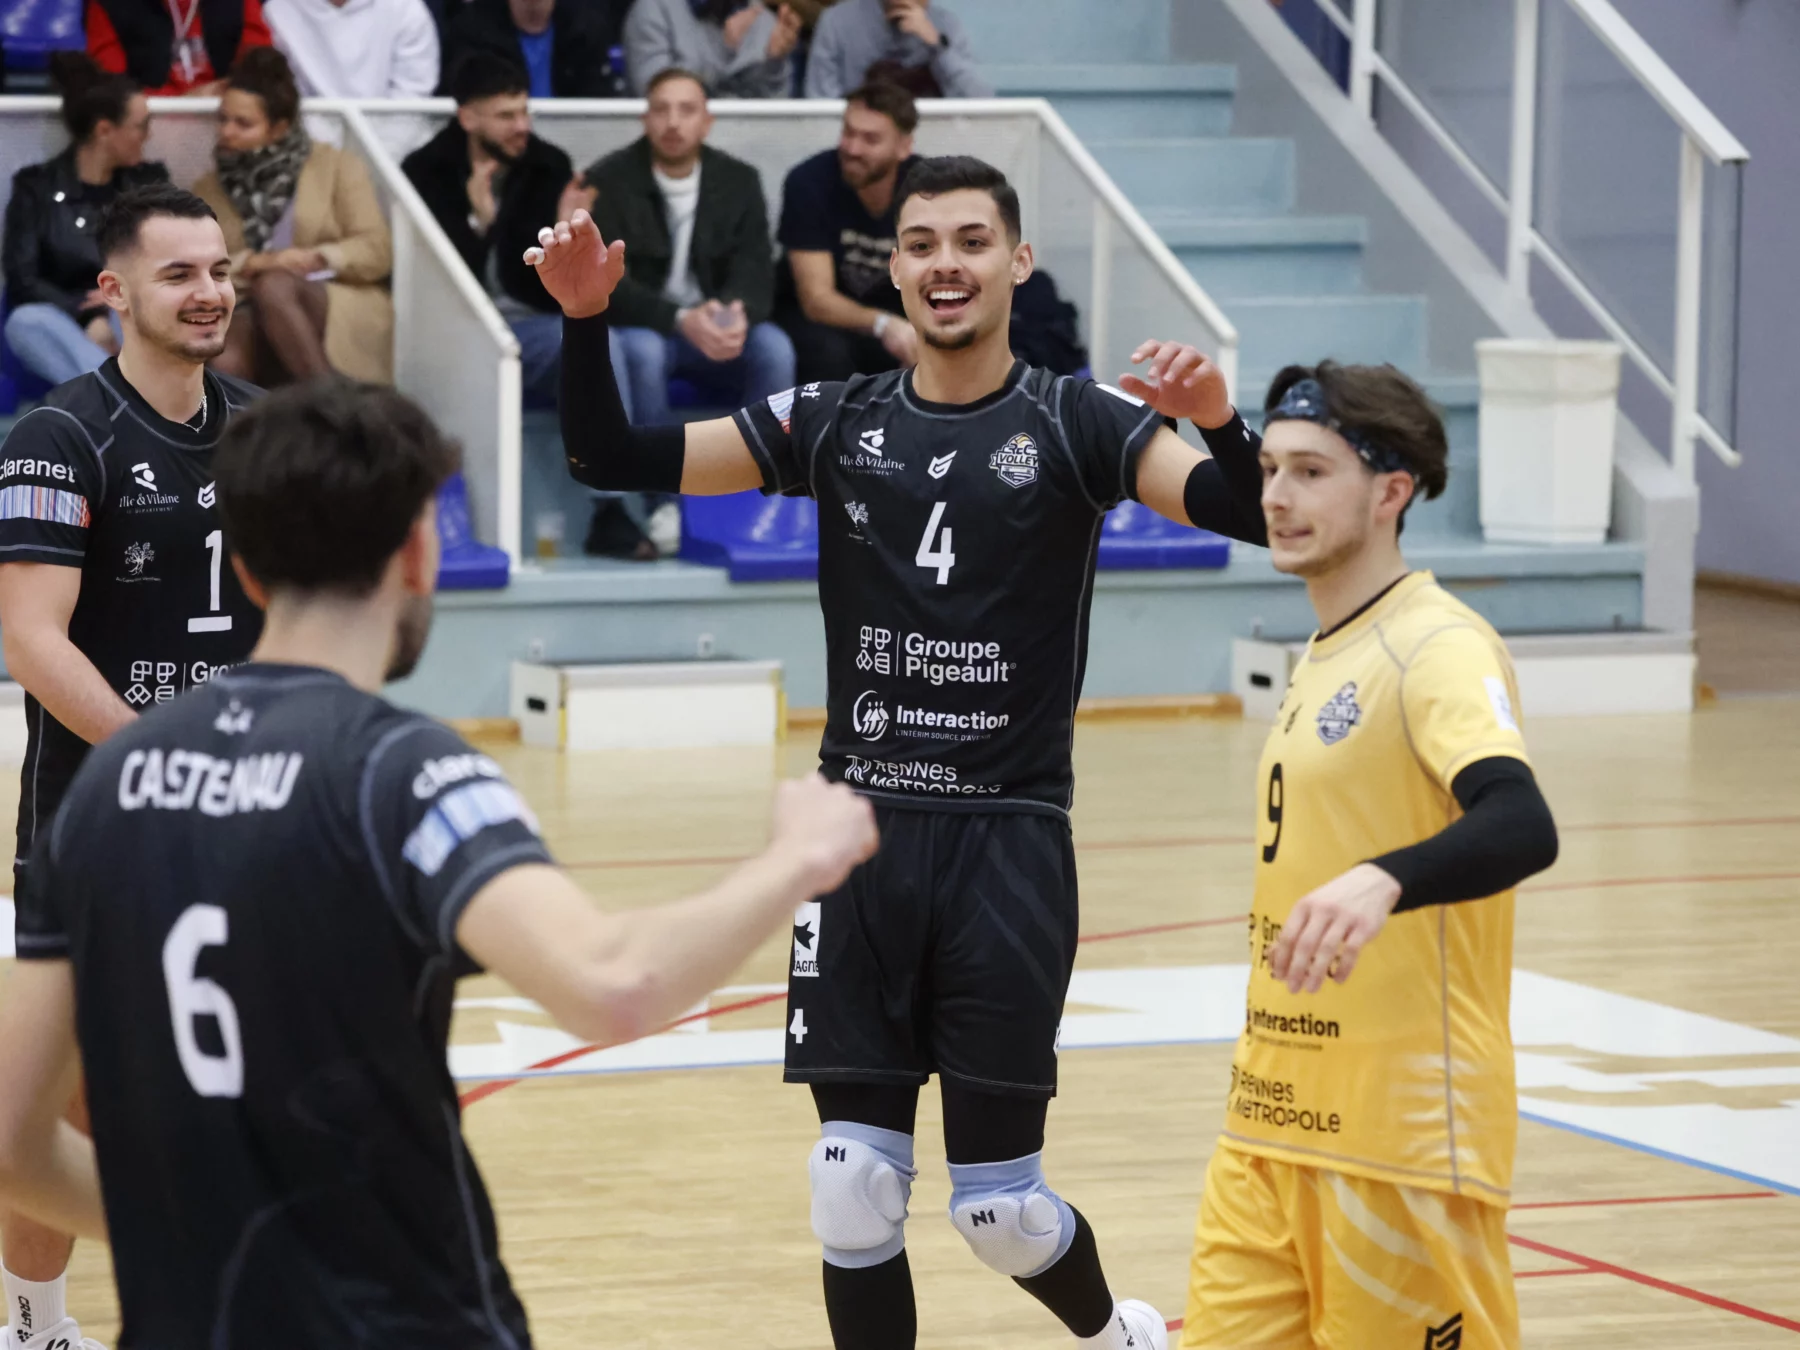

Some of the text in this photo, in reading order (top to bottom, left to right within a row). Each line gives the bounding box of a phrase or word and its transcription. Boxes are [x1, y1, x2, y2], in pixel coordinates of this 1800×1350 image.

[866, 456, 905, 470] Vilaine
[999, 454, 1038, 466] VOLLEY
[146, 493, 180, 505] Vilaine
[915, 502, 955, 585] 4
[205, 530, 222, 611] 1
[905, 632, 1000, 665] Groupe
[896, 705, 1009, 730] Interaction
[931, 732, 959, 741] SOURCE
[1262, 763, 1283, 863] 9
[162, 903, 245, 1098] 6
[789, 1008, 808, 1044] 4
[825, 1147, 846, 1162] N1
[971, 1209, 996, 1226] N1
[18, 1295, 32, 1329] CRAFT
